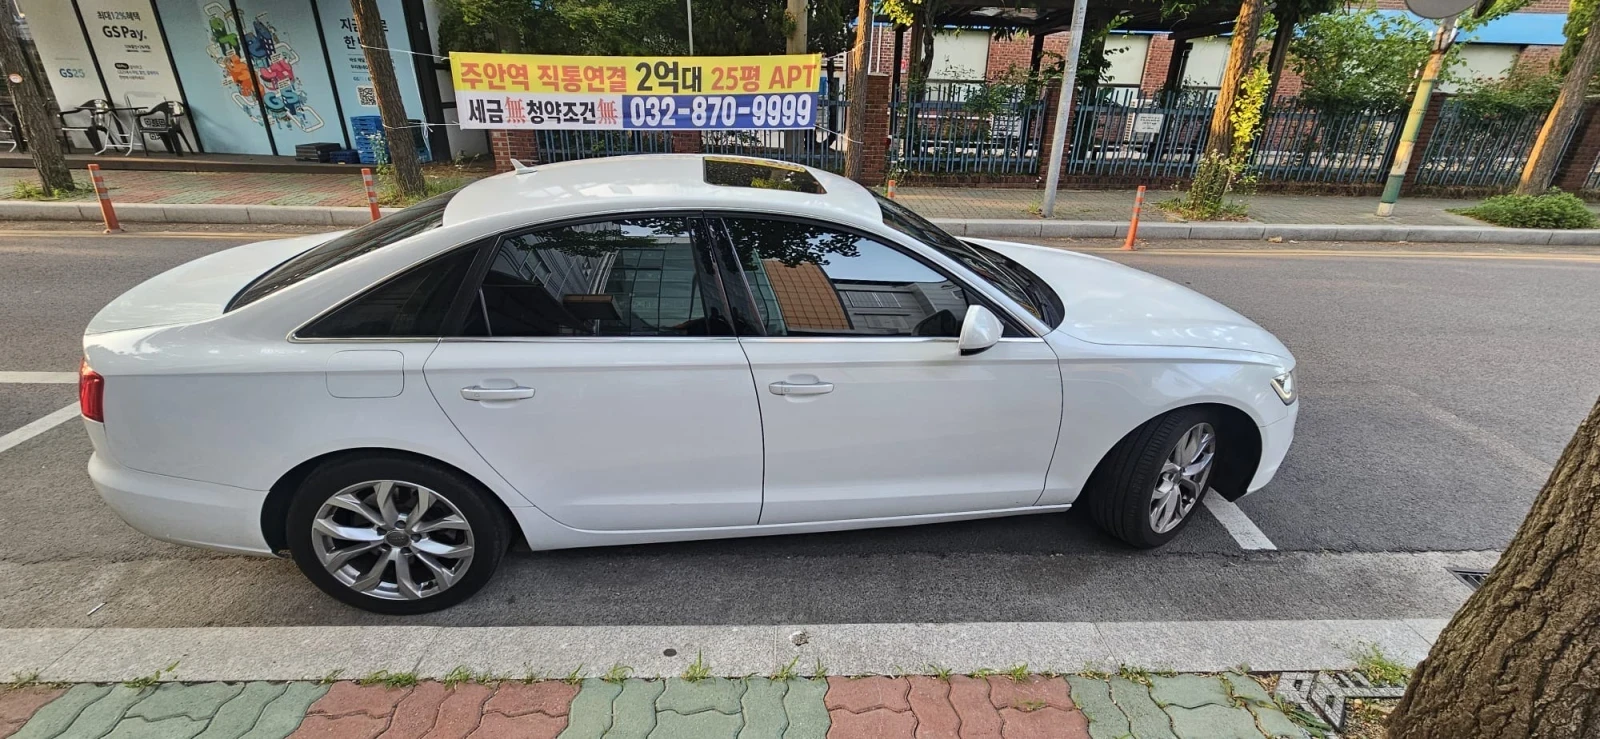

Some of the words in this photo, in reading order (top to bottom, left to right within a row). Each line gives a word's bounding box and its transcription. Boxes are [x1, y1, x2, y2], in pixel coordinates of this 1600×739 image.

[343, 35, 357, 50] 한
[59, 68, 86, 78] GS25
[460, 62, 530, 91] 주안역
[538, 64, 627, 93] 직통연결
[635, 61, 702, 93] 2억대
[711, 64, 761, 92] 25평
[768, 64, 817, 90] APT
[630, 94, 812, 127] 032-870-9999
